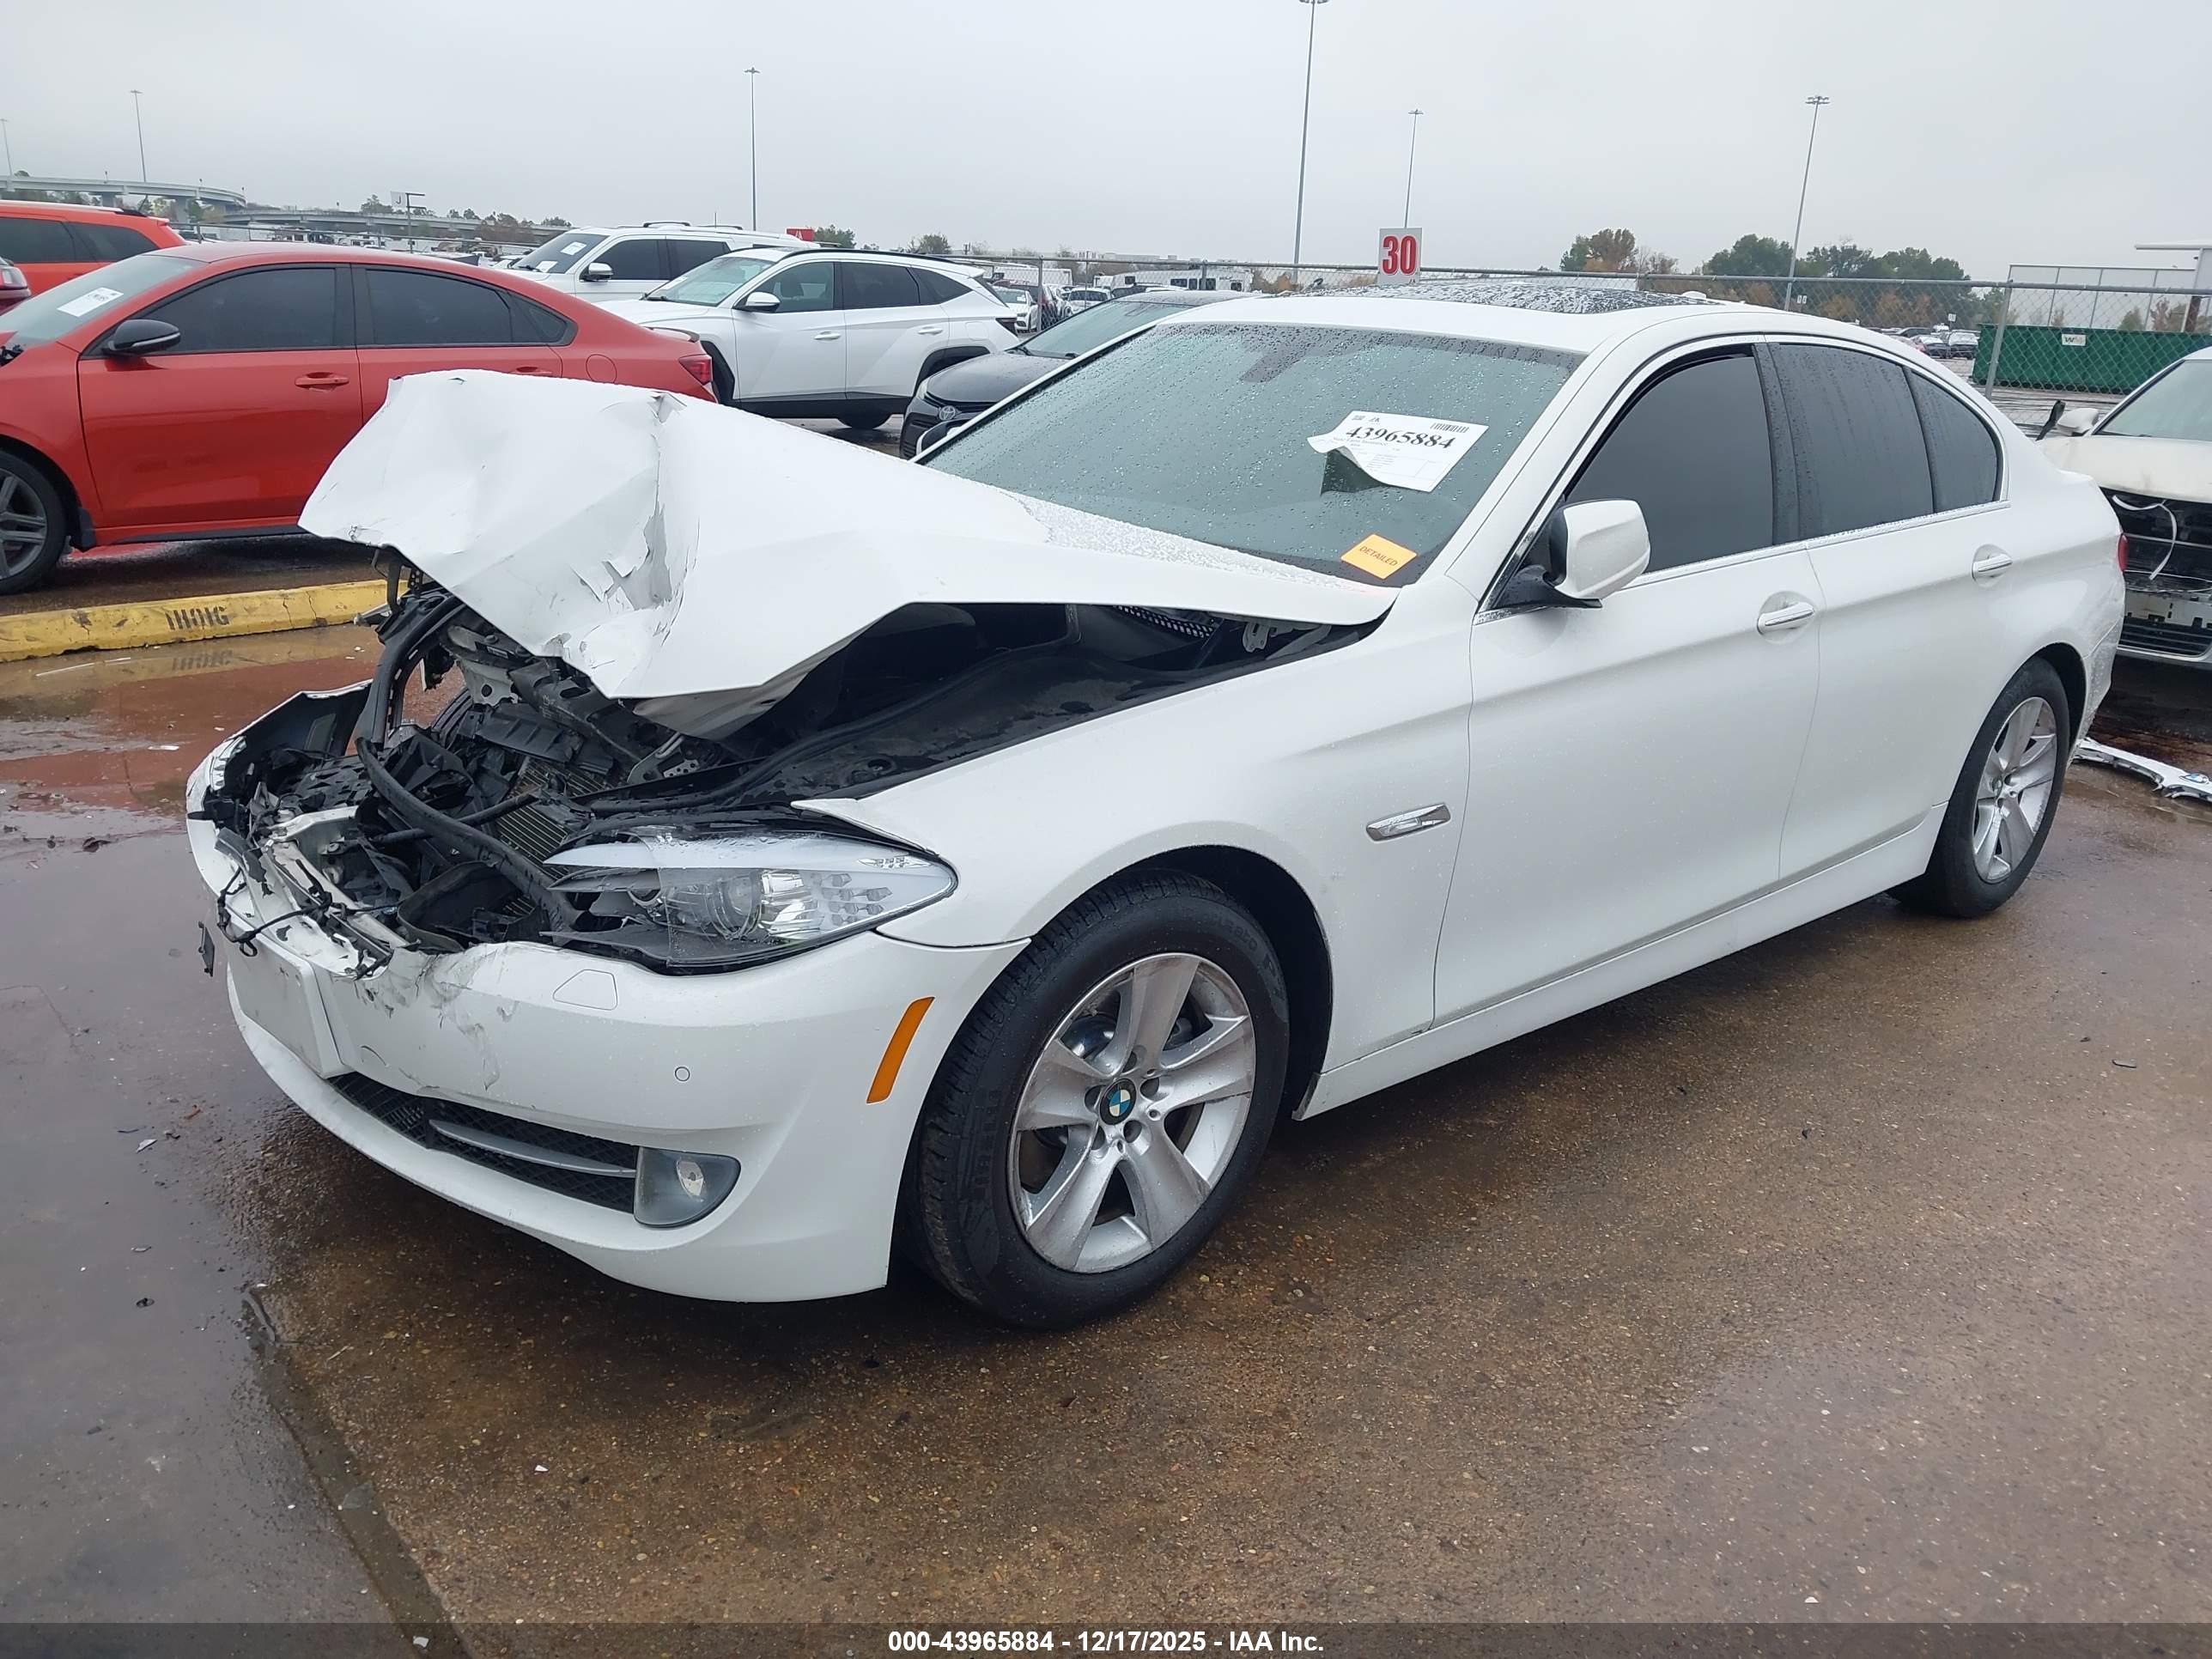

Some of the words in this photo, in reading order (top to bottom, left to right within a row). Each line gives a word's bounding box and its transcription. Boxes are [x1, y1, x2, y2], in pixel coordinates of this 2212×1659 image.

[1382, 235, 1417, 275] 30
[1346, 426, 1456, 449] 43965884
[1359, 545, 1399, 567] DETAILED
